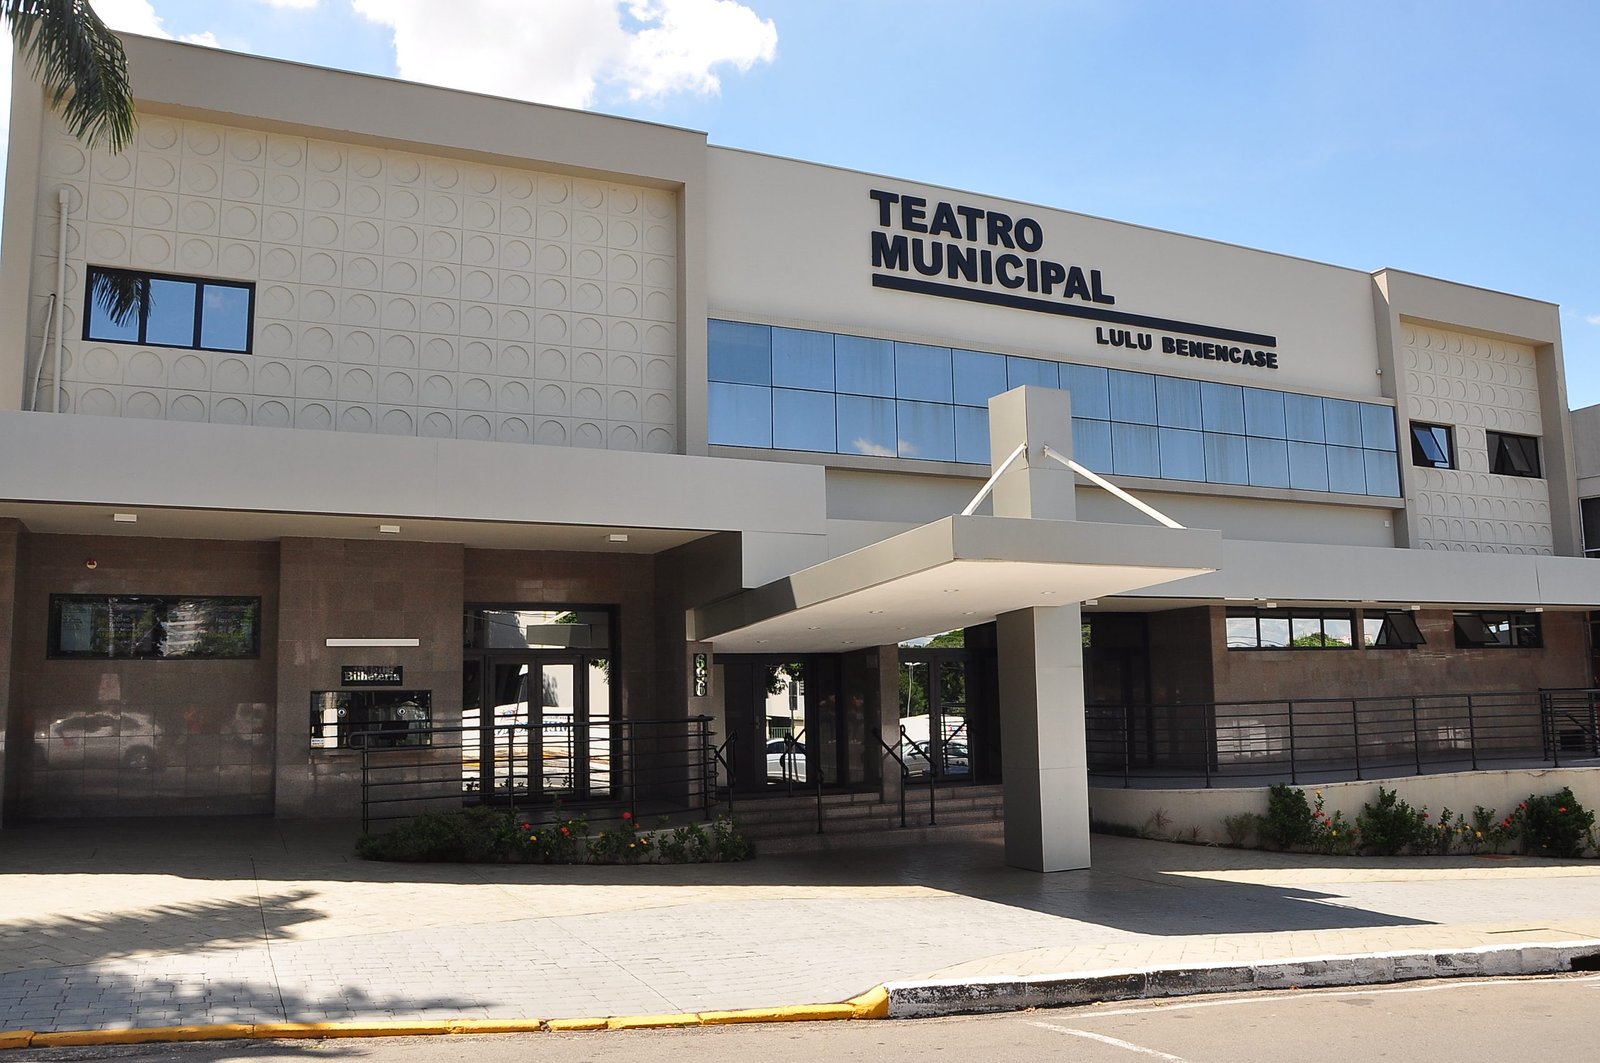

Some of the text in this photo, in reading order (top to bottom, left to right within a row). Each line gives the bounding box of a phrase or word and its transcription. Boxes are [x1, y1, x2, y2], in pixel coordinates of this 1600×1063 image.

[870, 189, 1043, 253] TEATRO
[871, 230, 1115, 305] MUNICIPAL
[1096, 326, 1279, 369] LULU BENENCASE
[344, 671, 400, 681] Bilheteria
